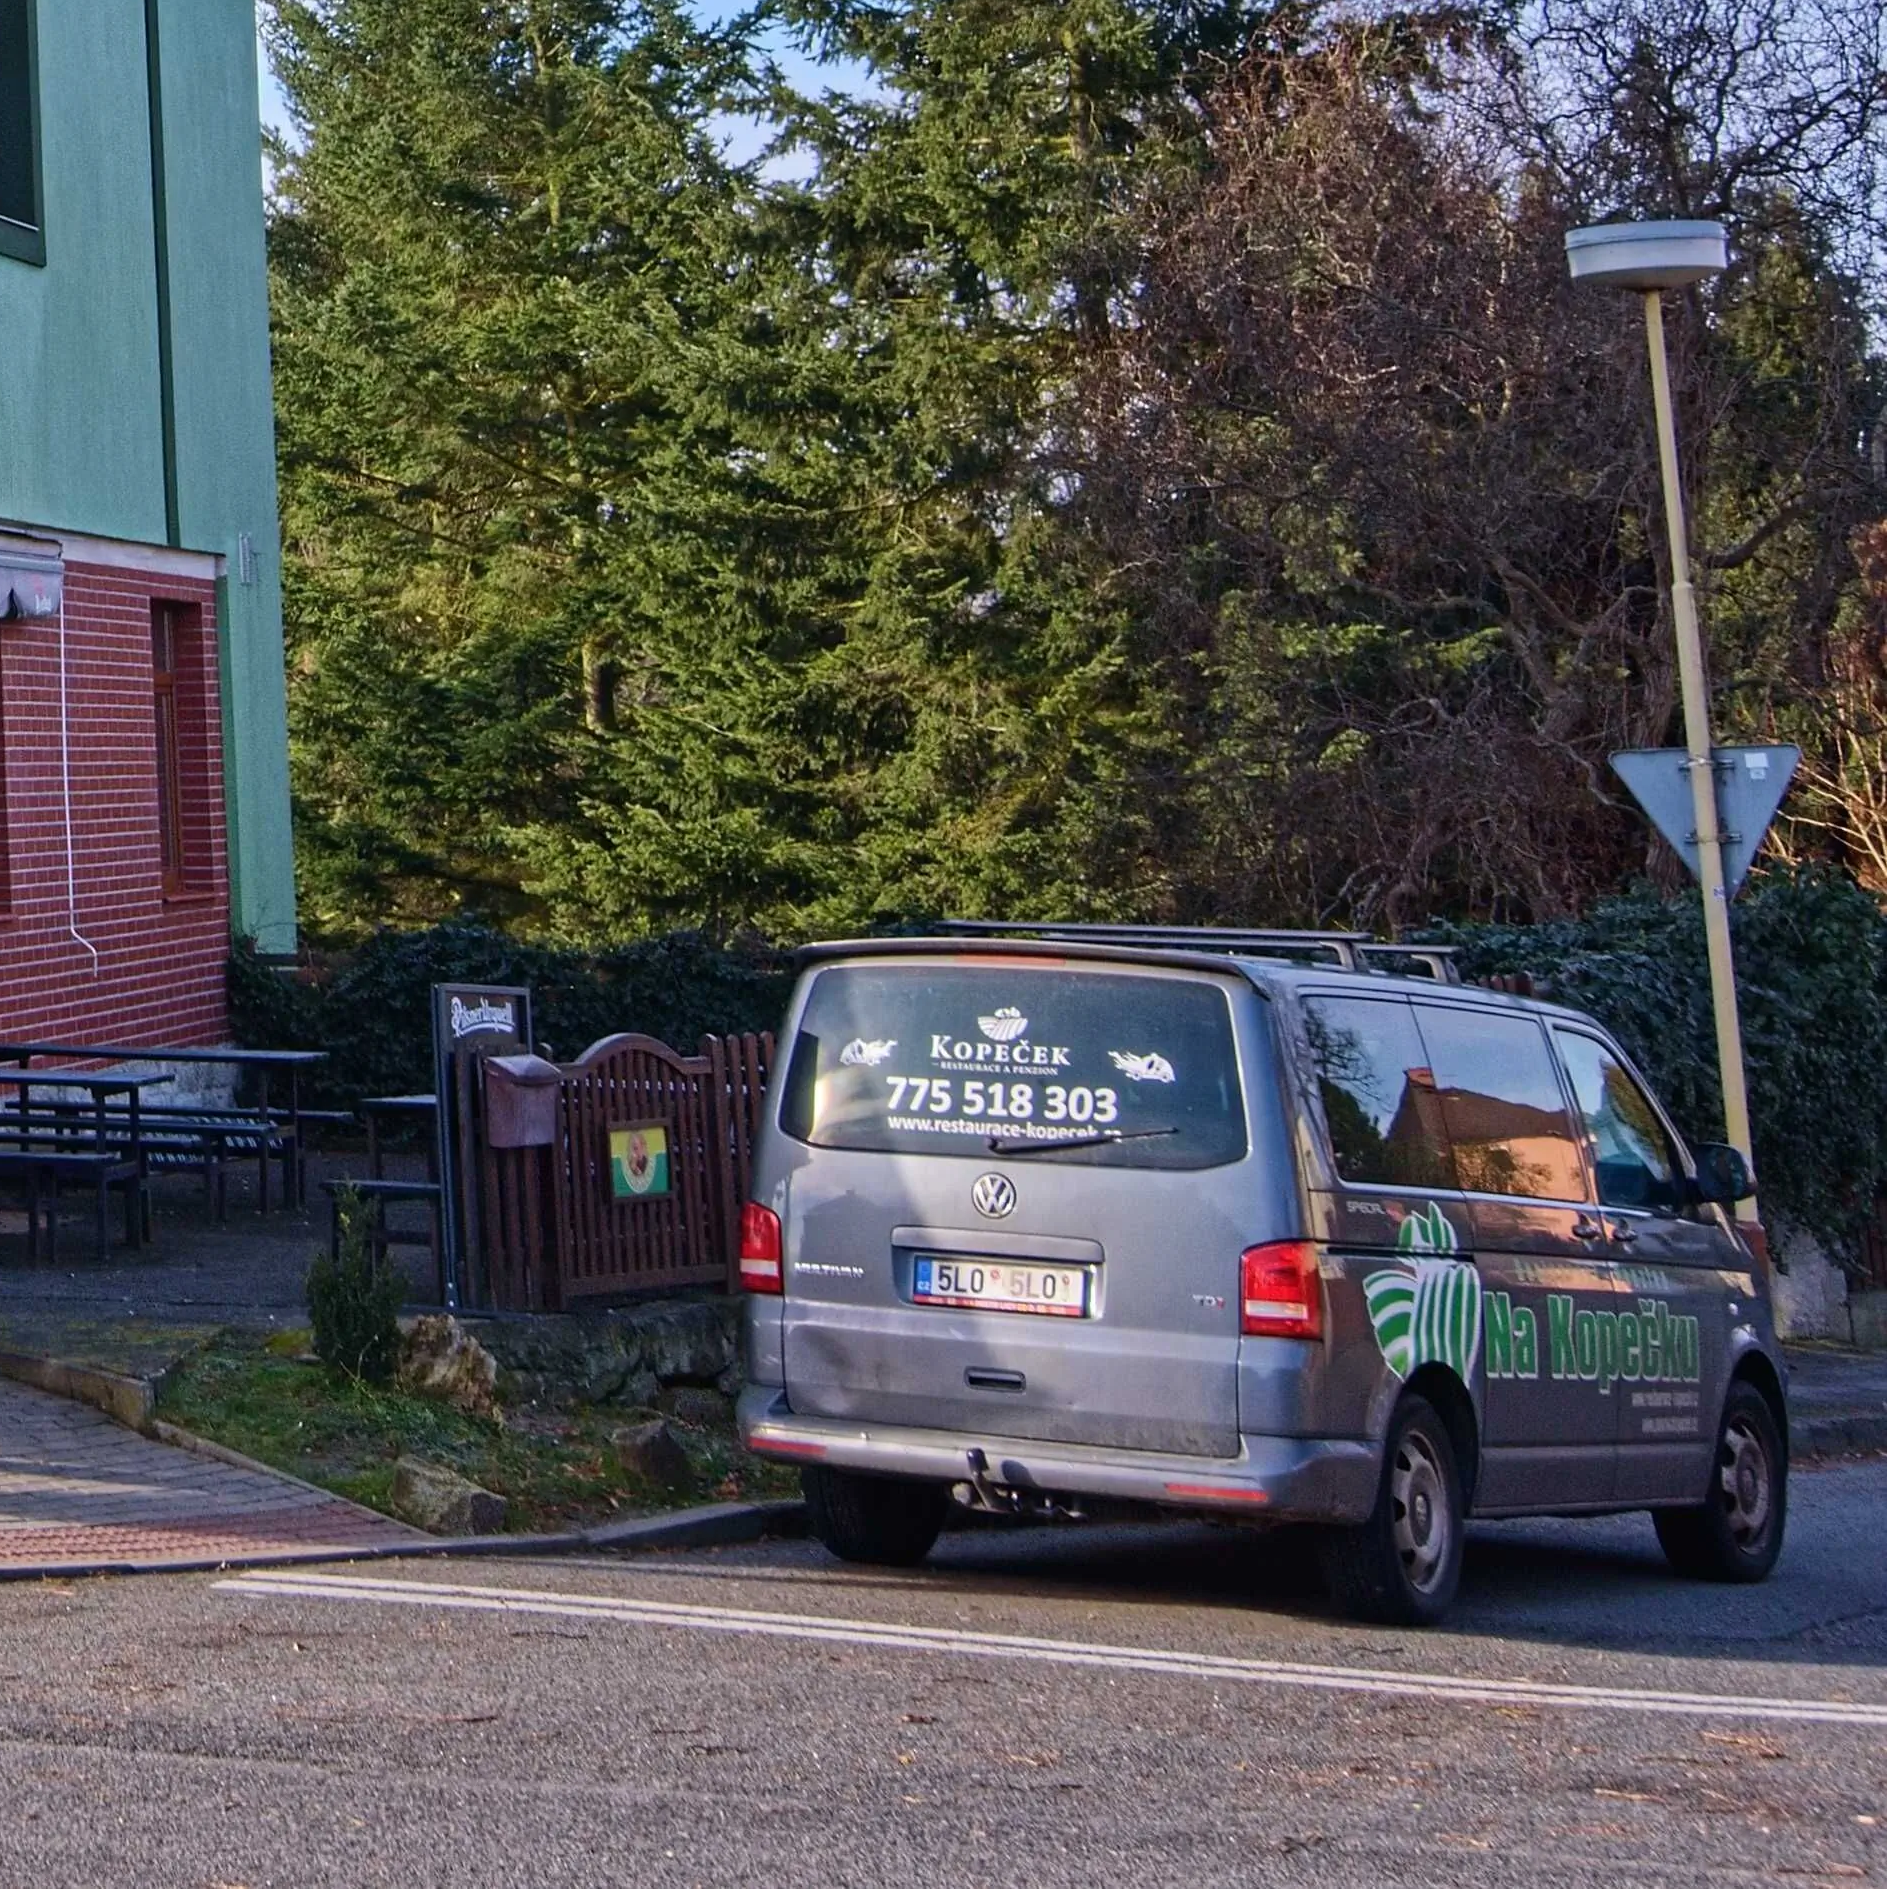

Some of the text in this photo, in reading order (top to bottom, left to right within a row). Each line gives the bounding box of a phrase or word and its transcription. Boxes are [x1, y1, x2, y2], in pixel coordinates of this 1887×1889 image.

[930, 1034, 1071, 1066] KOPEČEK
[885, 1076, 1118, 1123] 775 518 303
[1483, 1290, 1700, 1395] Na Kopečku
